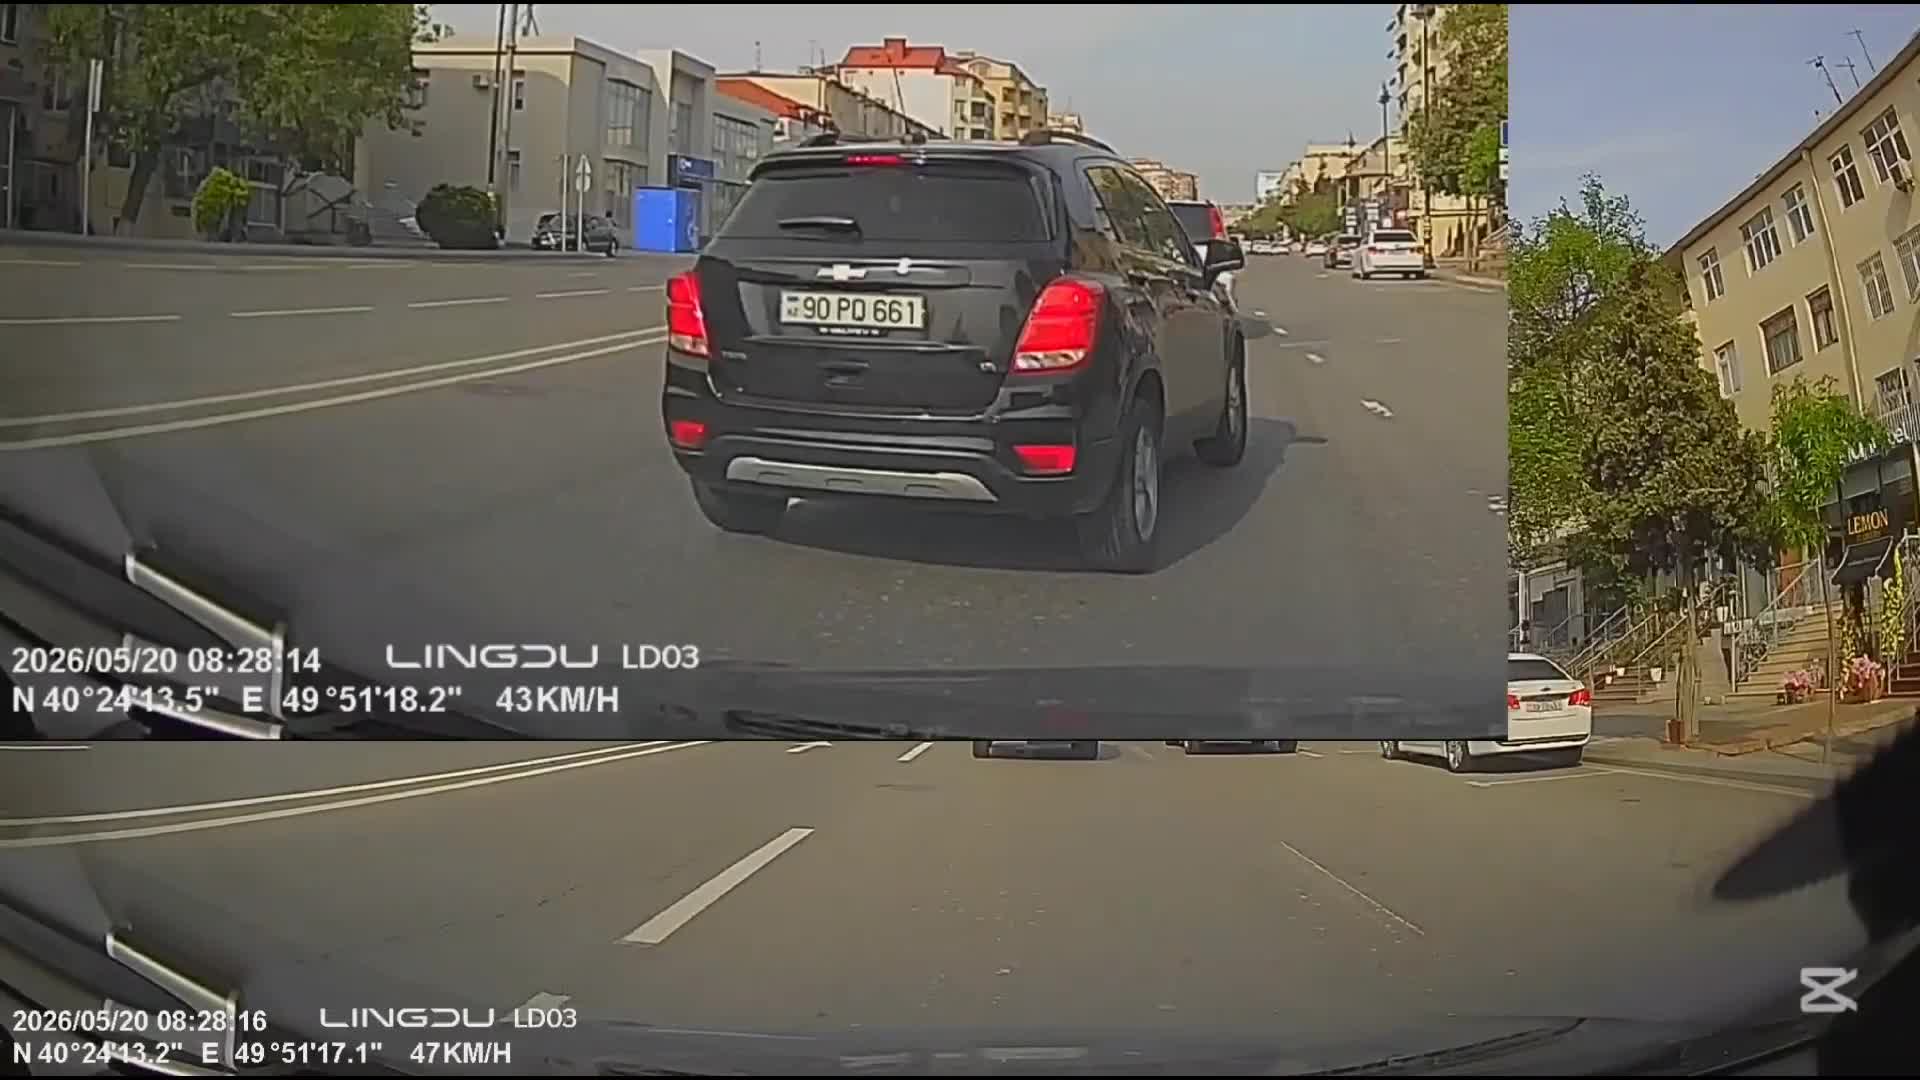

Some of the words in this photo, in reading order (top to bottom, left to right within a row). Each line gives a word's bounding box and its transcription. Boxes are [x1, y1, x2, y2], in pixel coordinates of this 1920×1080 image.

[802, 296, 830, 320] 90
[873, 299, 915, 325] 661
[1847, 508, 1889, 535] LEMON
